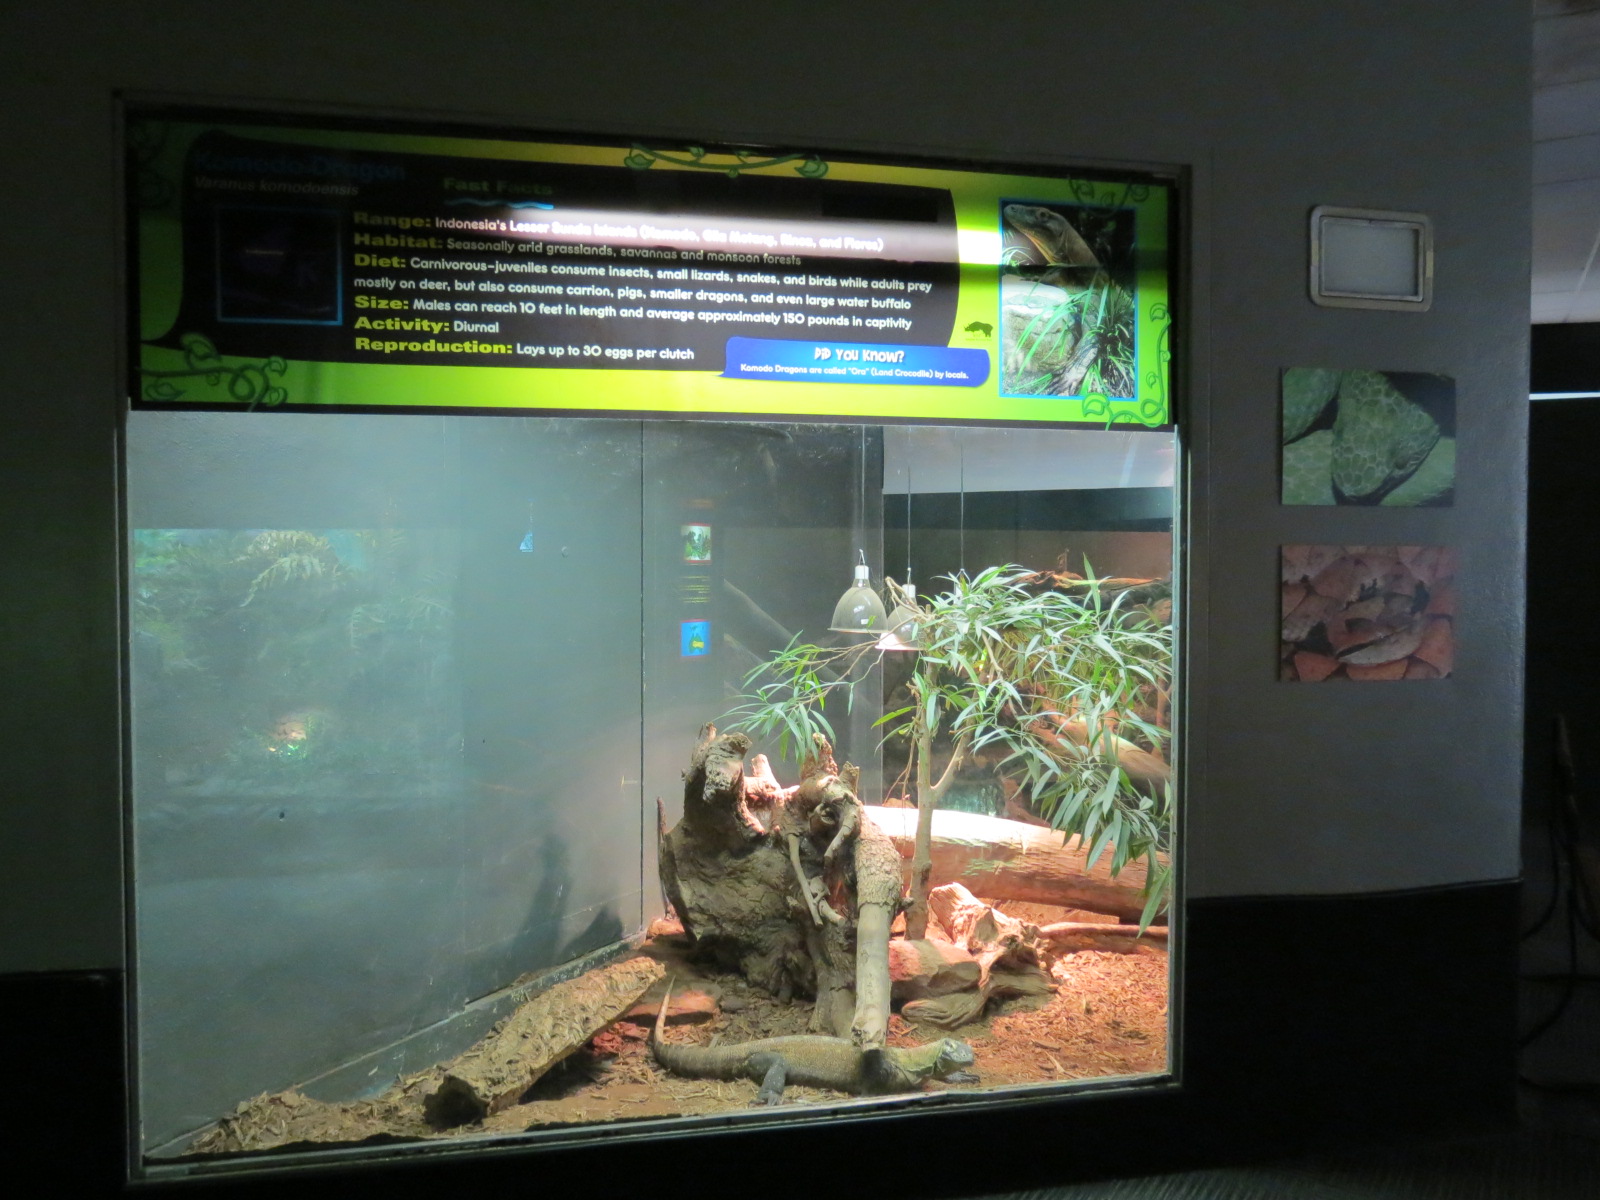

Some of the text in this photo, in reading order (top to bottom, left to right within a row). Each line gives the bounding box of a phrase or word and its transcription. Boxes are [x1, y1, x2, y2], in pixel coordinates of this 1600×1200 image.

[194, 176, 360, 197] Varanus komodoensis
[443, 177, 490, 192] Fast
[355, 212, 430, 228] Range:
[436, 217, 506, 231] Indonesia's
[510, 221, 550, 233] Lesser
[819, 237, 841, 248] and
[354, 233, 801, 265] Habitat: Seasonally arid grasslands, savannas and monsoon forests
[355, 253, 932, 293] Diet: Carnivorous-juveniles consume insects, small lizards, snakes, and birds while adults prey
[354, 277, 911, 310] mostly on deer, but also consume carrion, pigs, smaller dragons, and even large water buffalo
[354, 317, 499, 333] Activity: Diurnal
[355, 295, 912, 330] Size: Males can reach 10 feet in length and average approximately 150 pounds in captivity
[355, 337, 694, 360] Reproduction: Lays up to 30 eggs per clutch
[740, 364, 773, 372] Komodo
[775, 365, 807, 375] Dragons
[824, 366, 846, 375] called
[871, 368, 893, 377] (Land
[895, 369, 933, 378] Crocodile)
[935, 370, 945, 379] by
[946, 370, 969, 379] locals.
